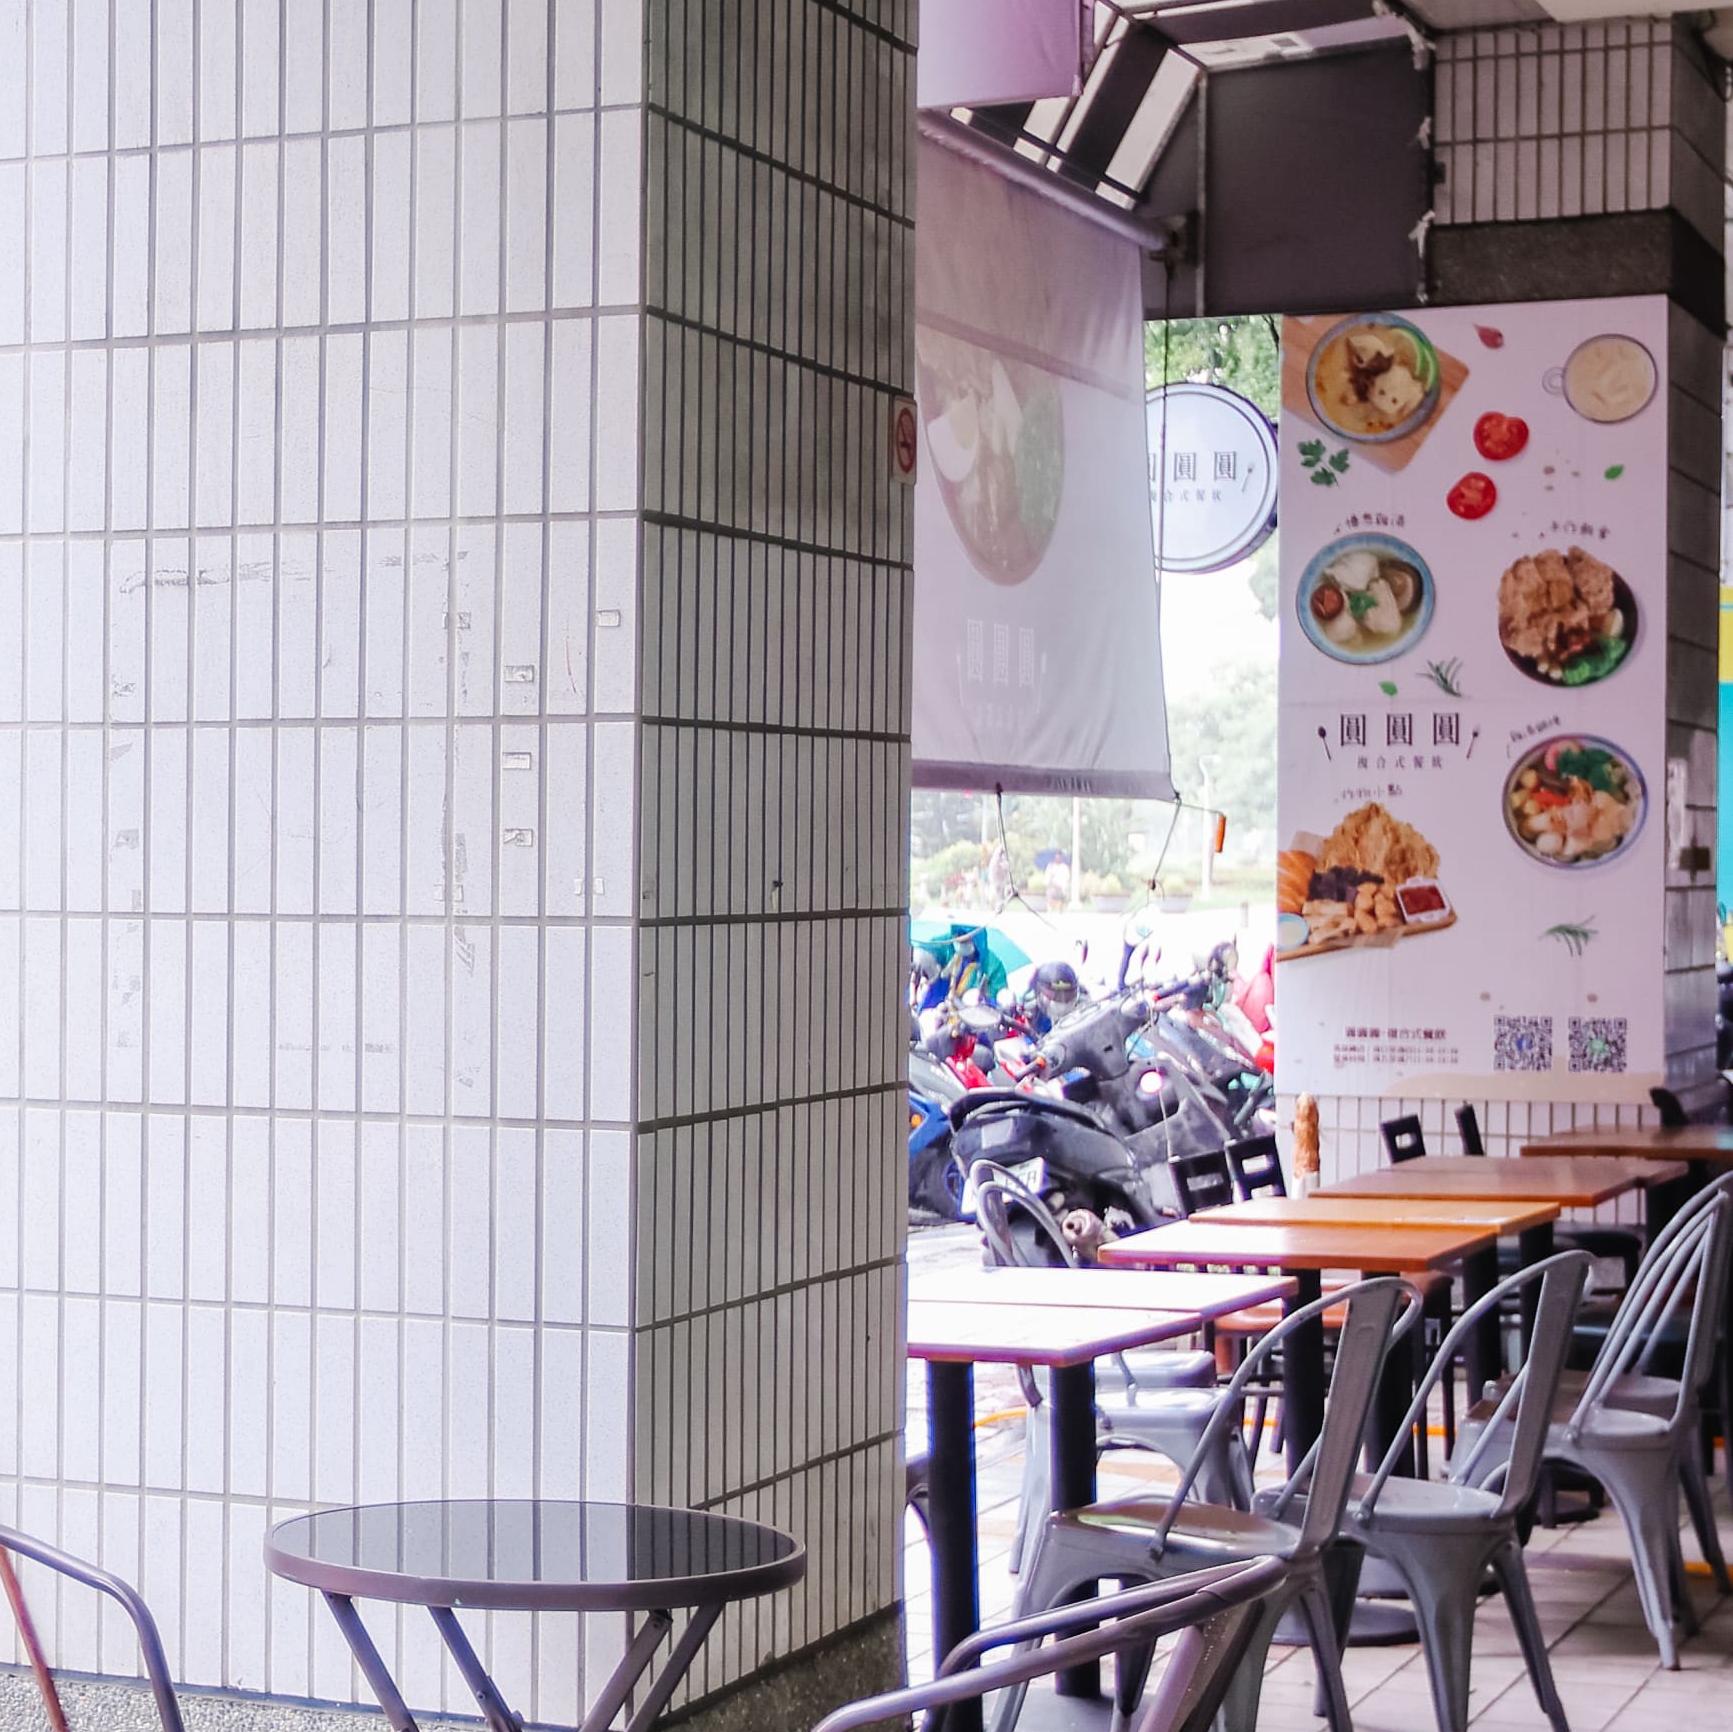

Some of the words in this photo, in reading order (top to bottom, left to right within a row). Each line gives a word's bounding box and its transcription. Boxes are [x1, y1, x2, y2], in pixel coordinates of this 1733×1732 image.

[1150, 451, 1236, 482] 圓圓
[1340, 712, 1460, 747] 圓圓圓
